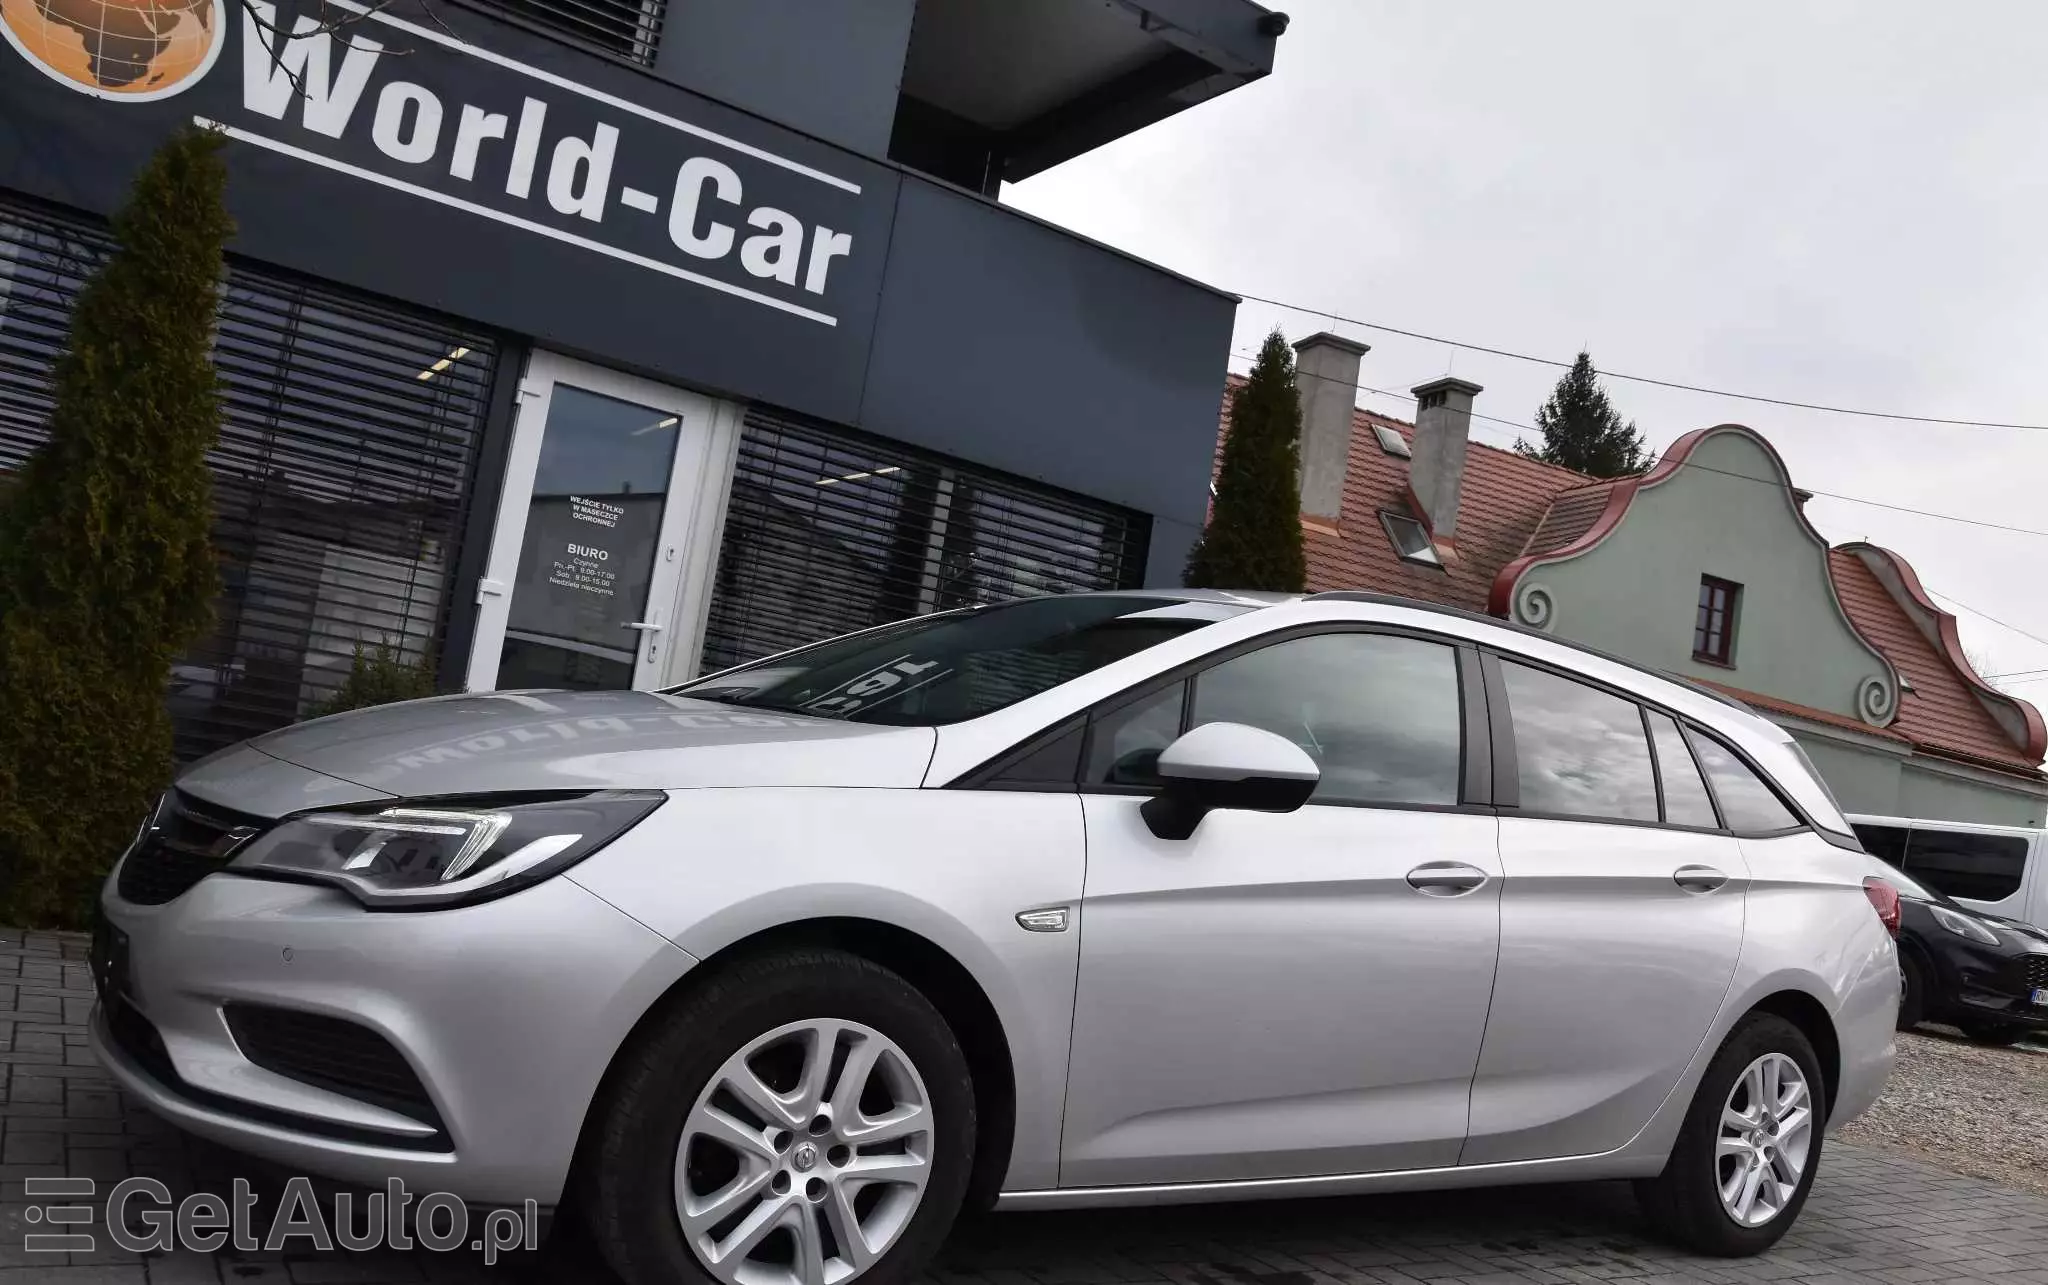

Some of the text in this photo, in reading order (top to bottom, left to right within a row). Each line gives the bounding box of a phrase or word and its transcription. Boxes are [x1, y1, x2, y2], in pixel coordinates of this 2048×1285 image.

[242, 0, 852, 295] World-Car
[570, 495, 624, 515] WEJŚCIE TYLKO
[581, 506, 618, 520] MASECZCE
[572, 512, 616, 528] OCHRONNEJ
[567, 543, 609, 560] BIURO
